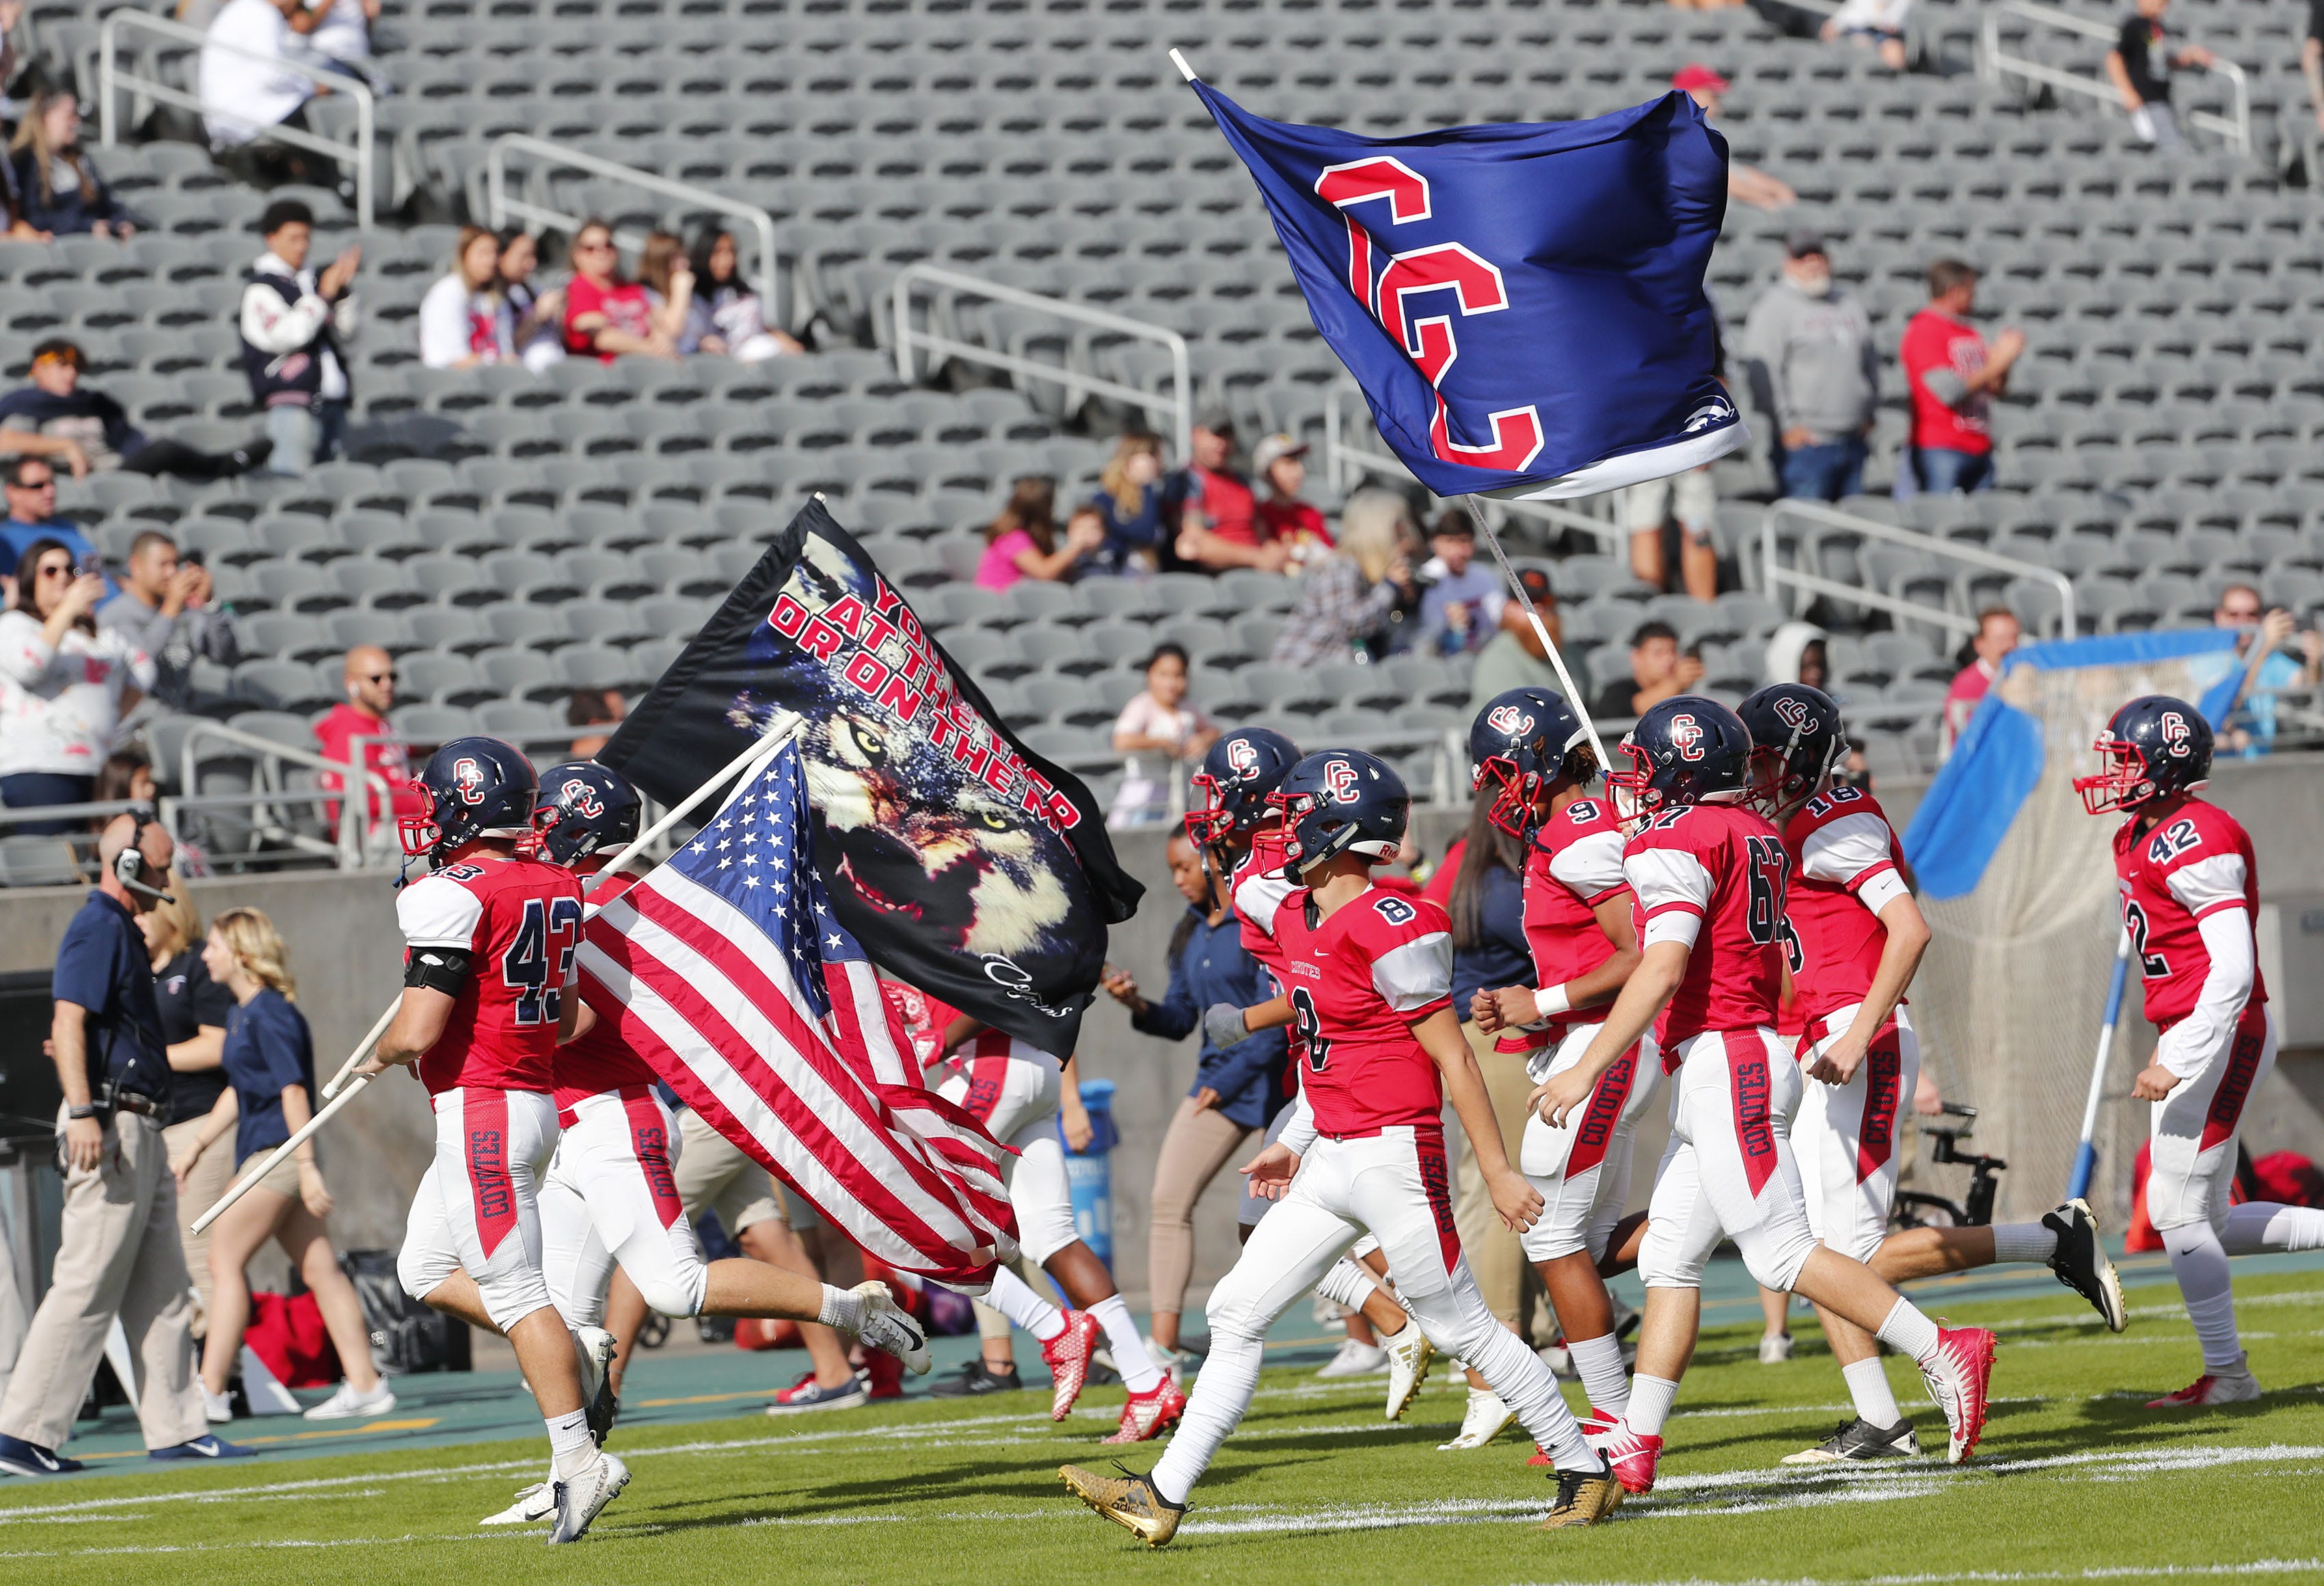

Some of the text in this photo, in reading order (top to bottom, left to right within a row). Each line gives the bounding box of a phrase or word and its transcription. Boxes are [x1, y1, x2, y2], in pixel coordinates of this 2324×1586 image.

[767, 593, 844, 669] OR
[841, 649, 923, 727] ON
[928, 708, 1016, 797] THE
[821, 593, 899, 654] AT
[901, 641, 974, 736] THE
[1671, 714, 1705, 762] CC
[1324, 760, 1360, 805] CC
[1565, 801, 1602, 824] 9
[1806, 786, 1863, 818] 18
[2148, 819, 2202, 865] 42
[1373, 896, 1417, 926] 8
[1744, 835, 1792, 945] 67
[502, 896, 583, 1025] 43
[1291, 960, 1321, 980] COYOTES
[1580, 1060, 1631, 1146] COYOTES
[1737, 1062, 1772, 1157] COYOTES
[1865, 1051, 1896, 1144] COYOTES
[2213, 1034, 2261, 1123] COYOTES
[1111, 1501, 1154, 1517] adidas
